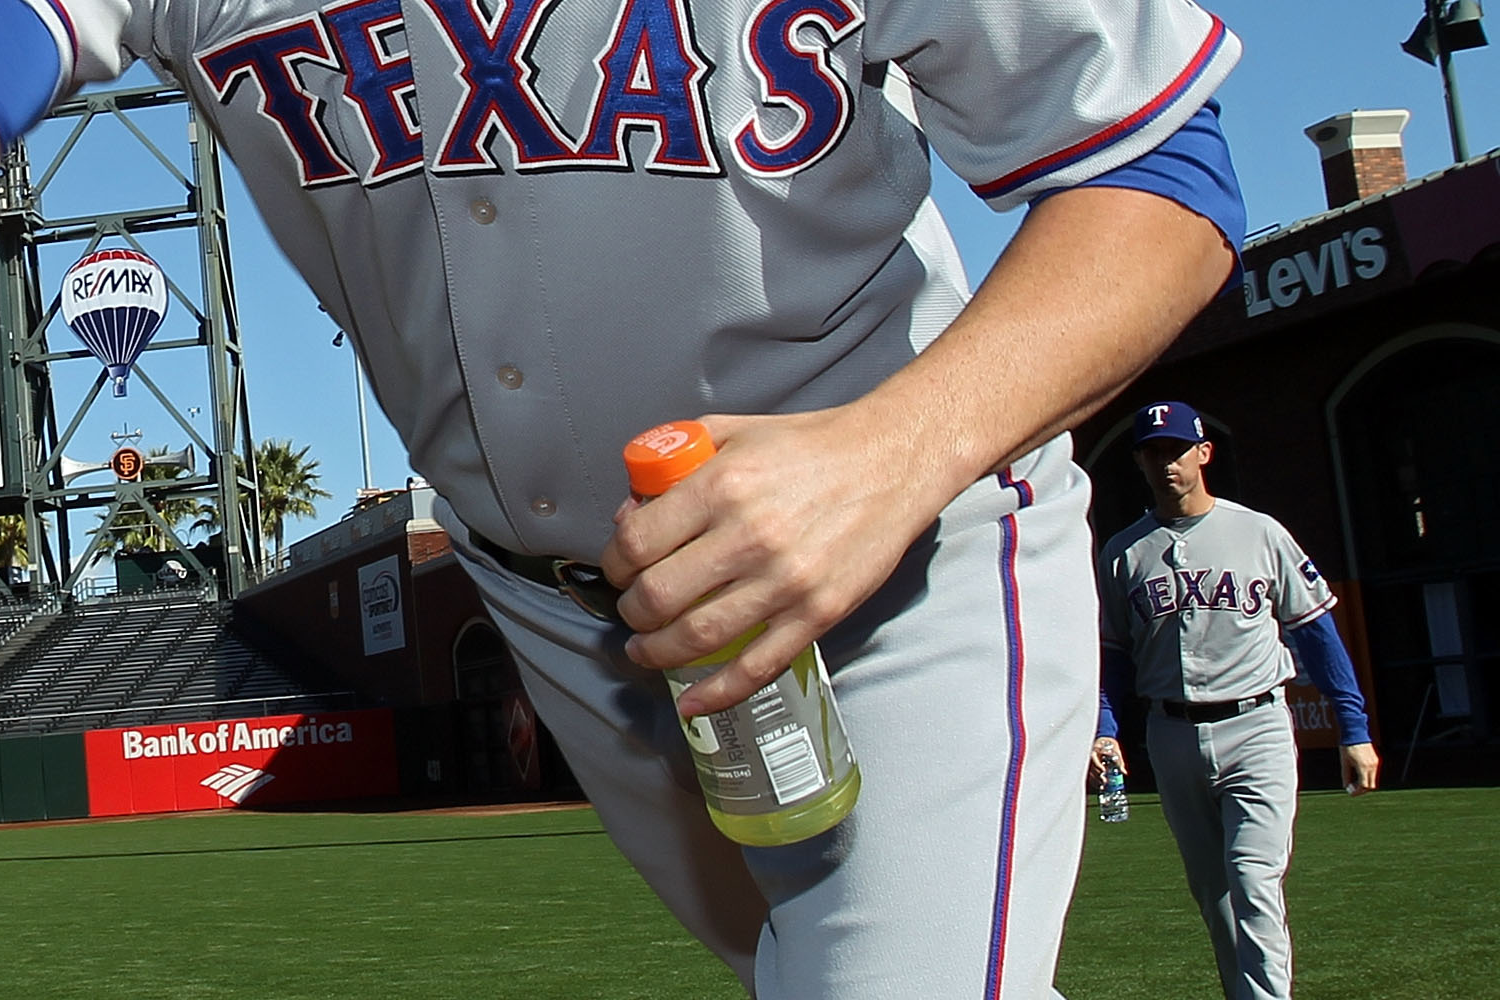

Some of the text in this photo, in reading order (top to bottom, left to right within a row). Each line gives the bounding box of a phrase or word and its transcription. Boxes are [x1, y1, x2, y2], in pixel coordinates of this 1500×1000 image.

[72, 267, 153, 303] RE/MAX
[1148, 404, 1170, 427] T
[1129, 569, 1268, 624] TEXAS
[122, 717, 353, 759] Bank of America
